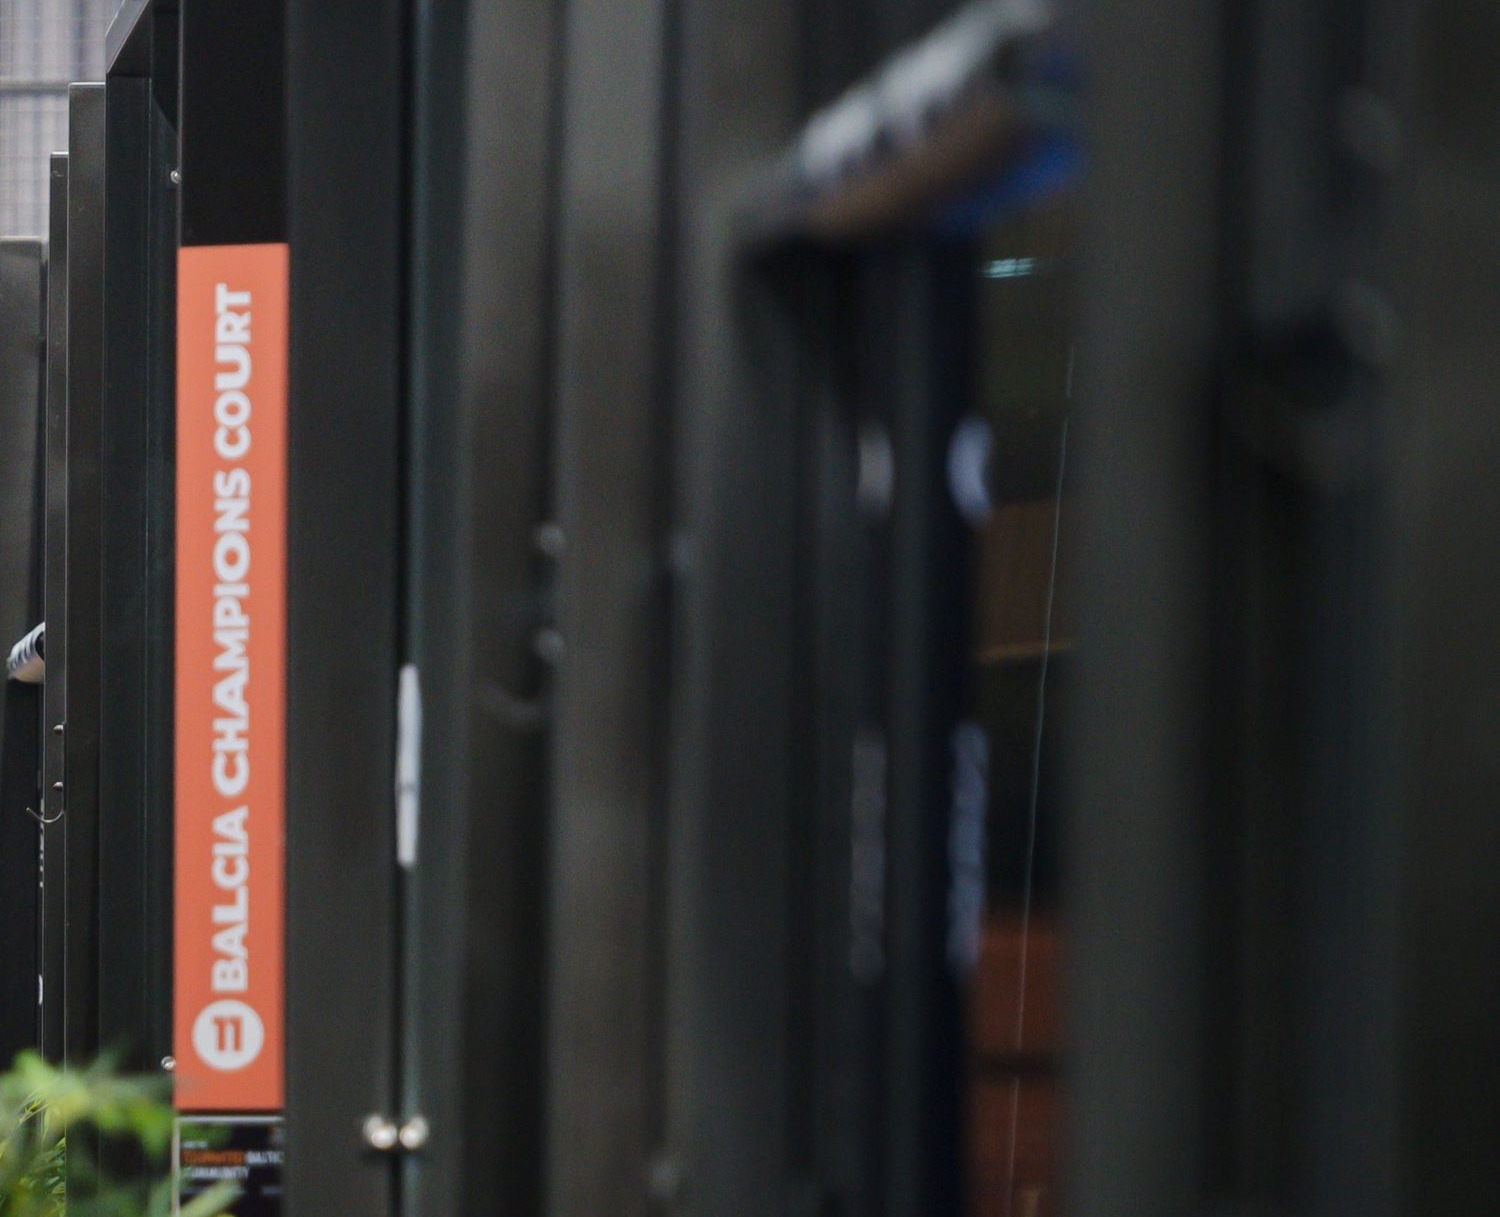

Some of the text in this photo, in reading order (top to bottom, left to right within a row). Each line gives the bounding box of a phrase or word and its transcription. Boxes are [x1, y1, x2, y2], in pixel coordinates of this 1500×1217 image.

[212, 282, 252, 992] BALCIA CHAMPIONS COURT
[213, 1016, 243, 1052] 11
